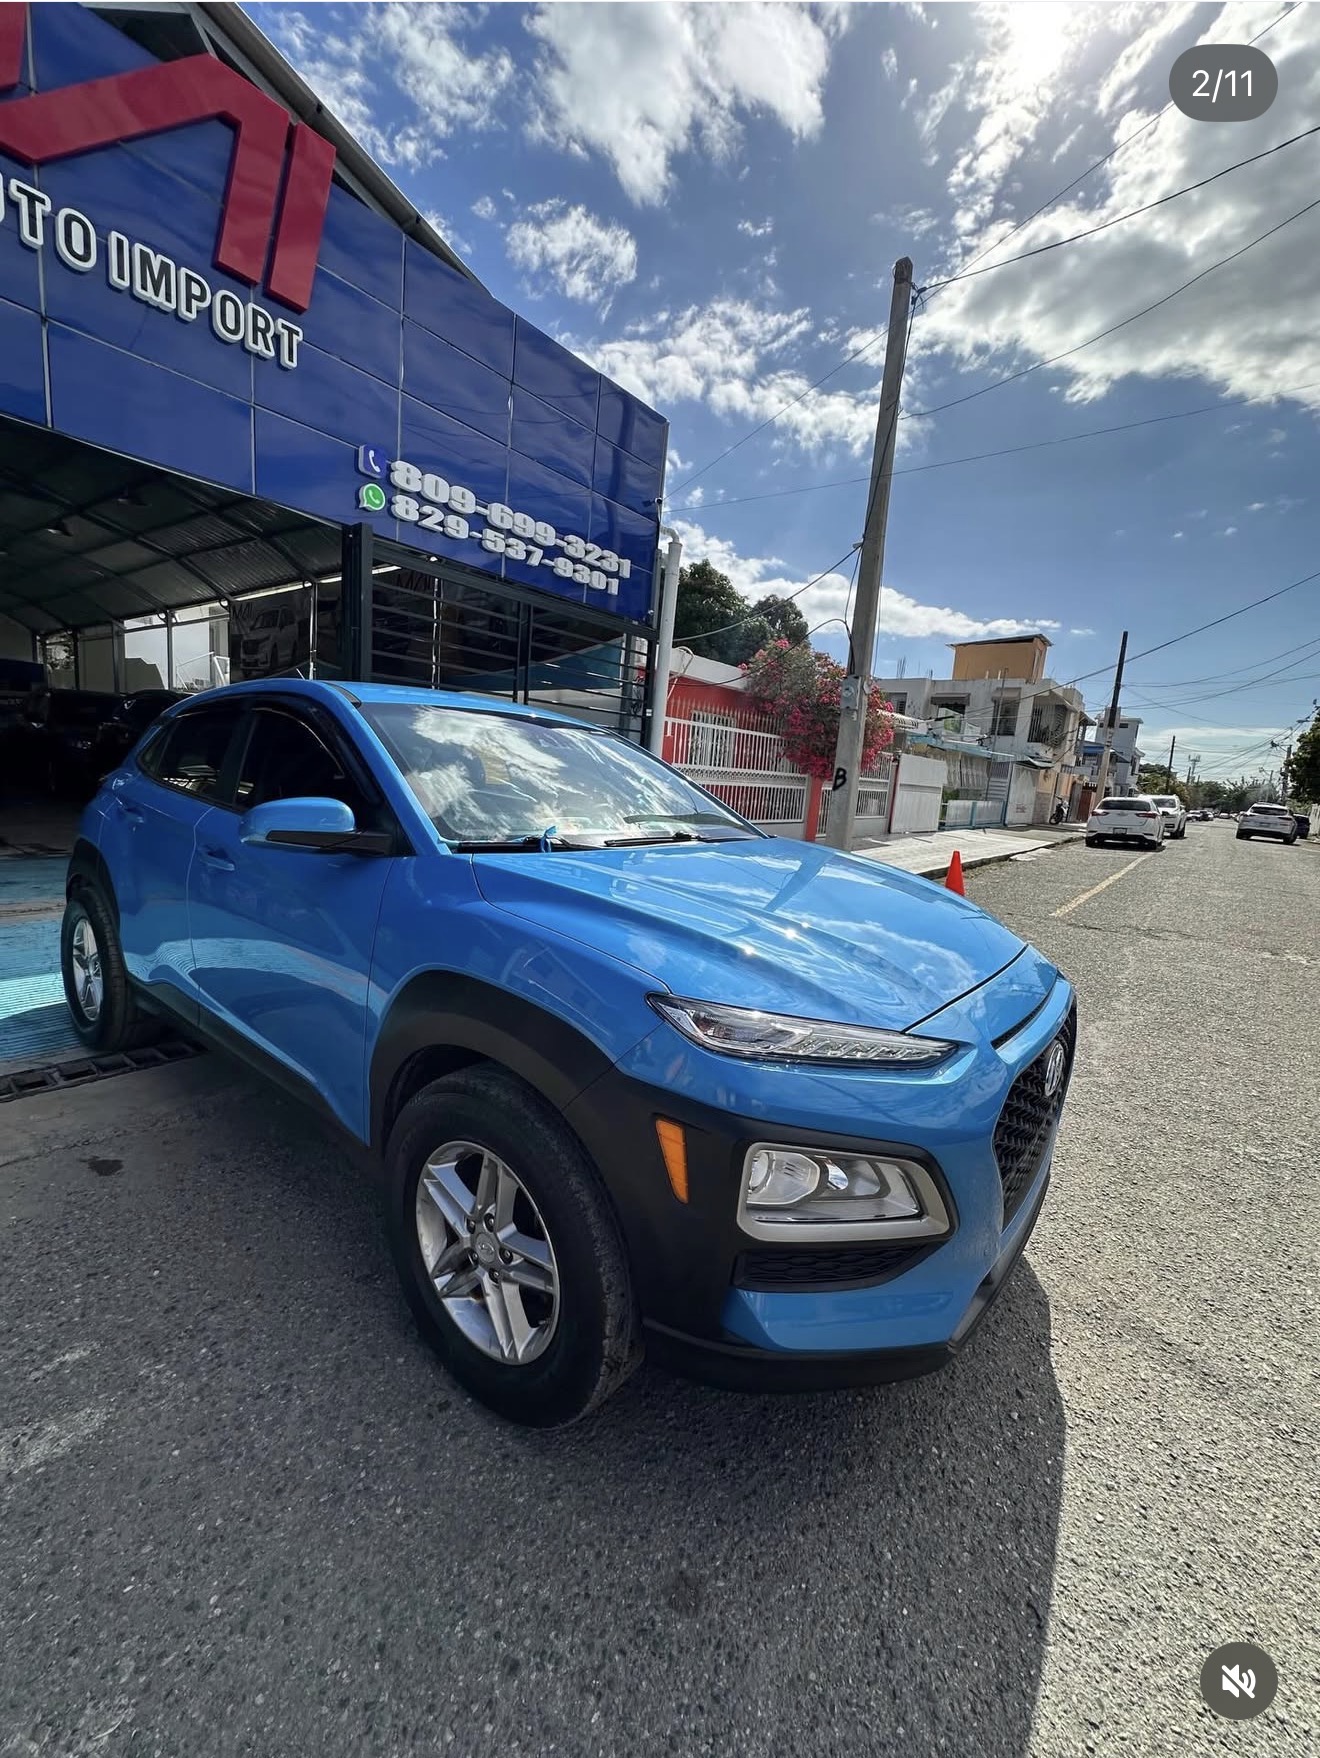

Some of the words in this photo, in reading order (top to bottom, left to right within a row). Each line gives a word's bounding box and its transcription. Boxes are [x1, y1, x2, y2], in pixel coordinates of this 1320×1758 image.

[0, 172, 97, 272] TO
[107, 230, 303, 370] IMPORT
[389, 460, 632, 579] 809-699-3231
[391, 494, 619, 596] 829-537-9301
[832, 767, 847, 791] B
